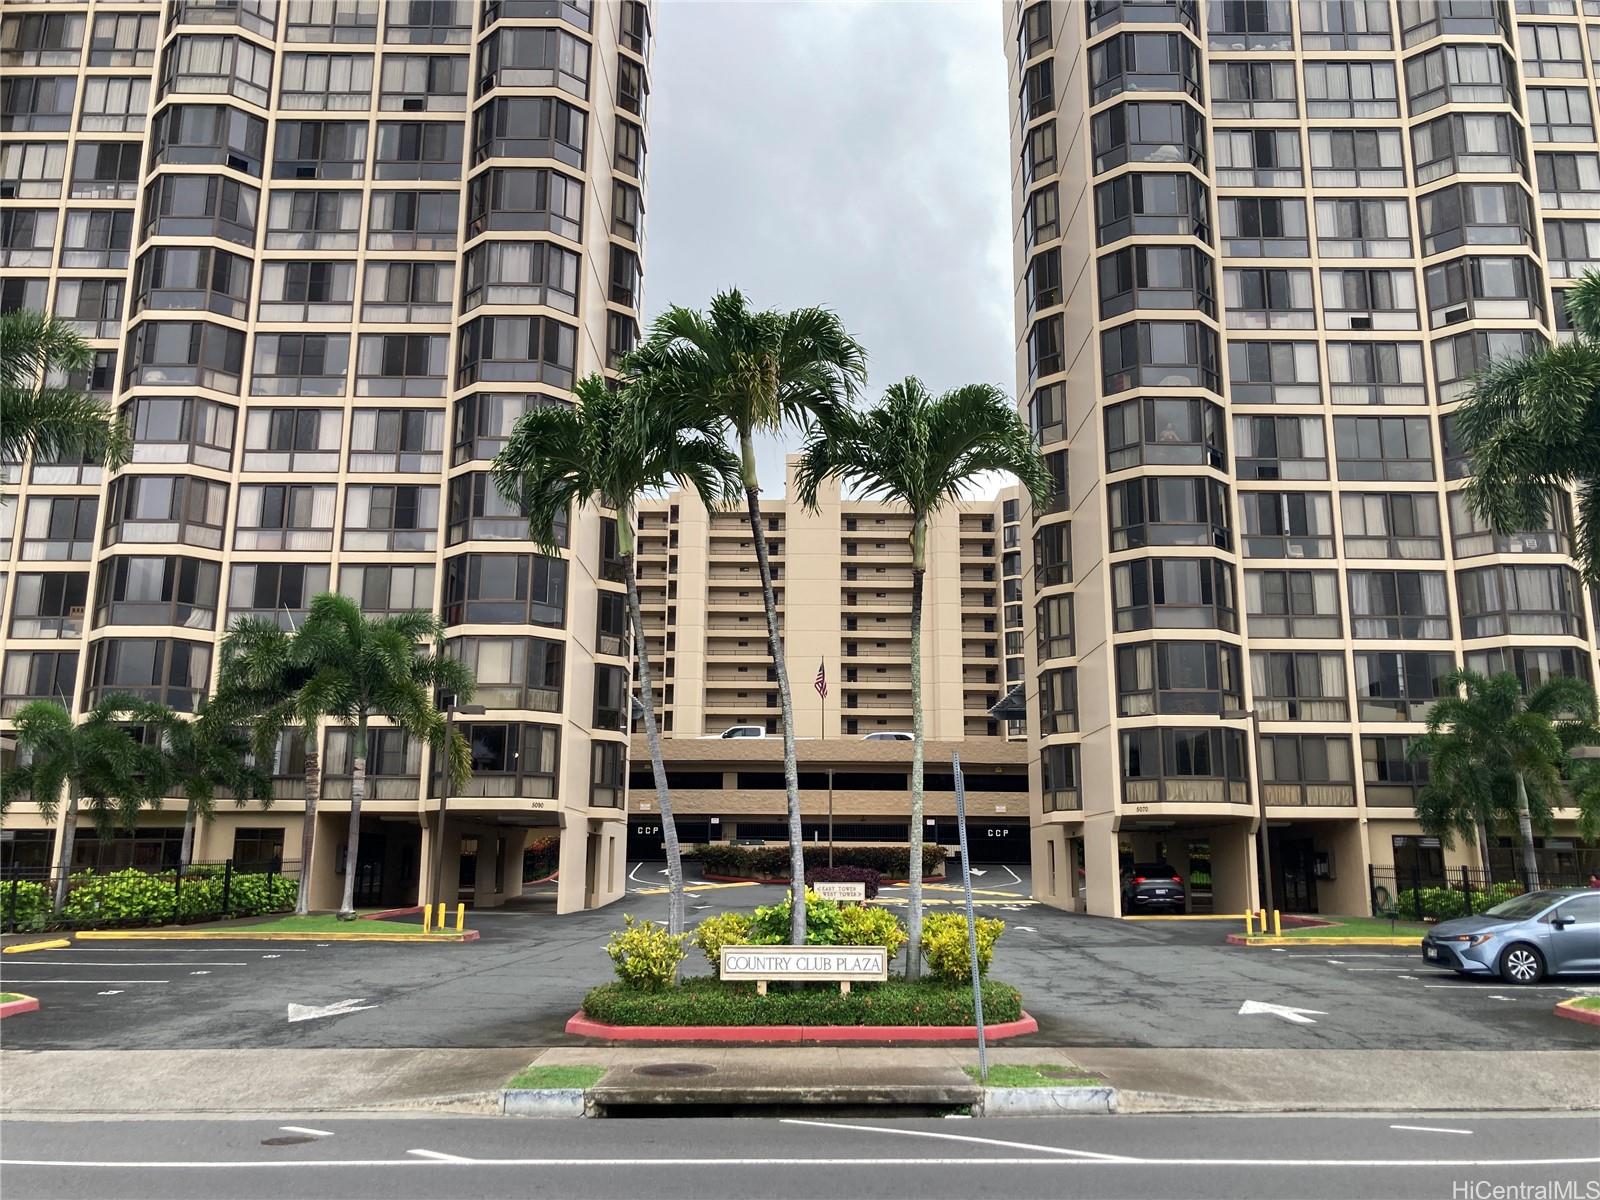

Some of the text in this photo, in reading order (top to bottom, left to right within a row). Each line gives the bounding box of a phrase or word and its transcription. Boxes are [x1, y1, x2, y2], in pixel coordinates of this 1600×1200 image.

[637, 826, 659, 834] CCP
[987, 829, 1009, 837] CCP
[726, 956, 881, 971] COUNTRY CLUB PLAZA
